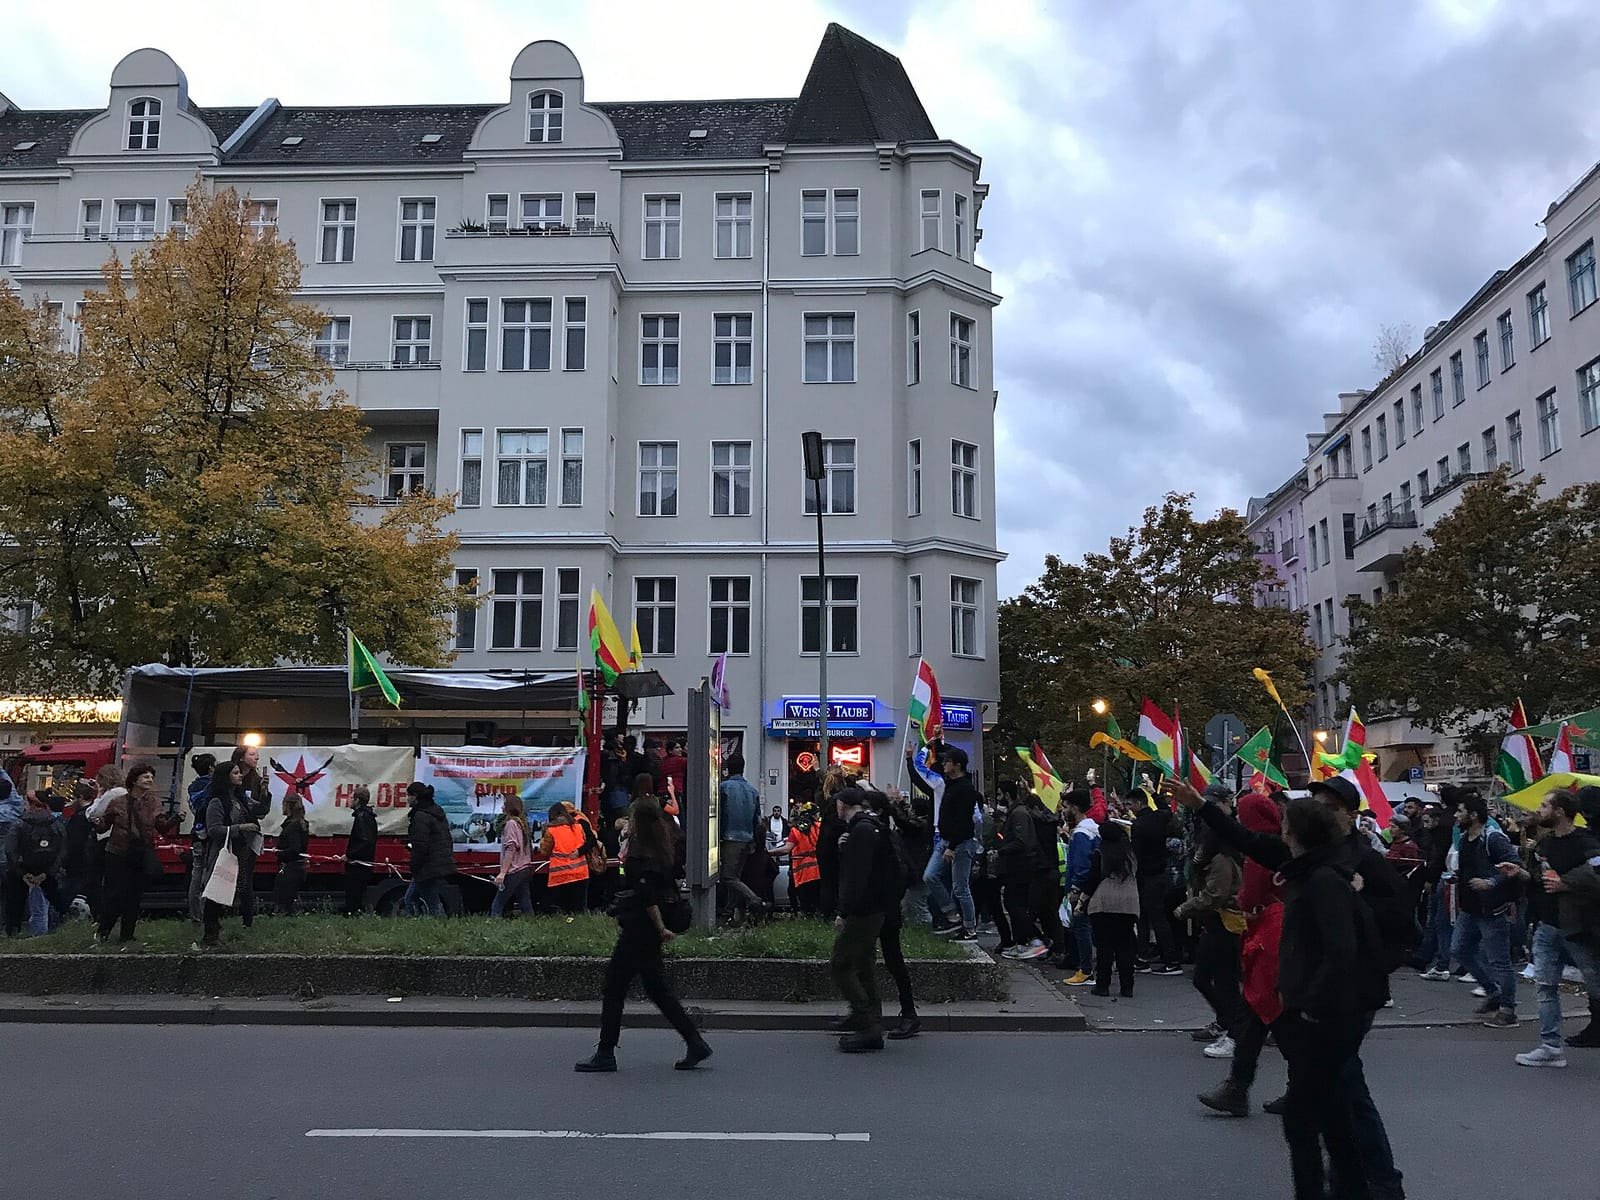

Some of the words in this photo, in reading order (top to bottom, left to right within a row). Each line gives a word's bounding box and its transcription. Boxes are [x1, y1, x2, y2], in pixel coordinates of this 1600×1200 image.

[834, 705, 868, 718] TAUBE
[945, 710, 969, 723] TAUBE
[775, 720, 794, 728] Wiener
[795, 720, 814, 728] Straße
[807, 729, 854, 737] FLEBURGER
[1411, 768, 1419, 778] P
[335, 782, 408, 808] HDE
[475, 783, 517, 796] Afrin
